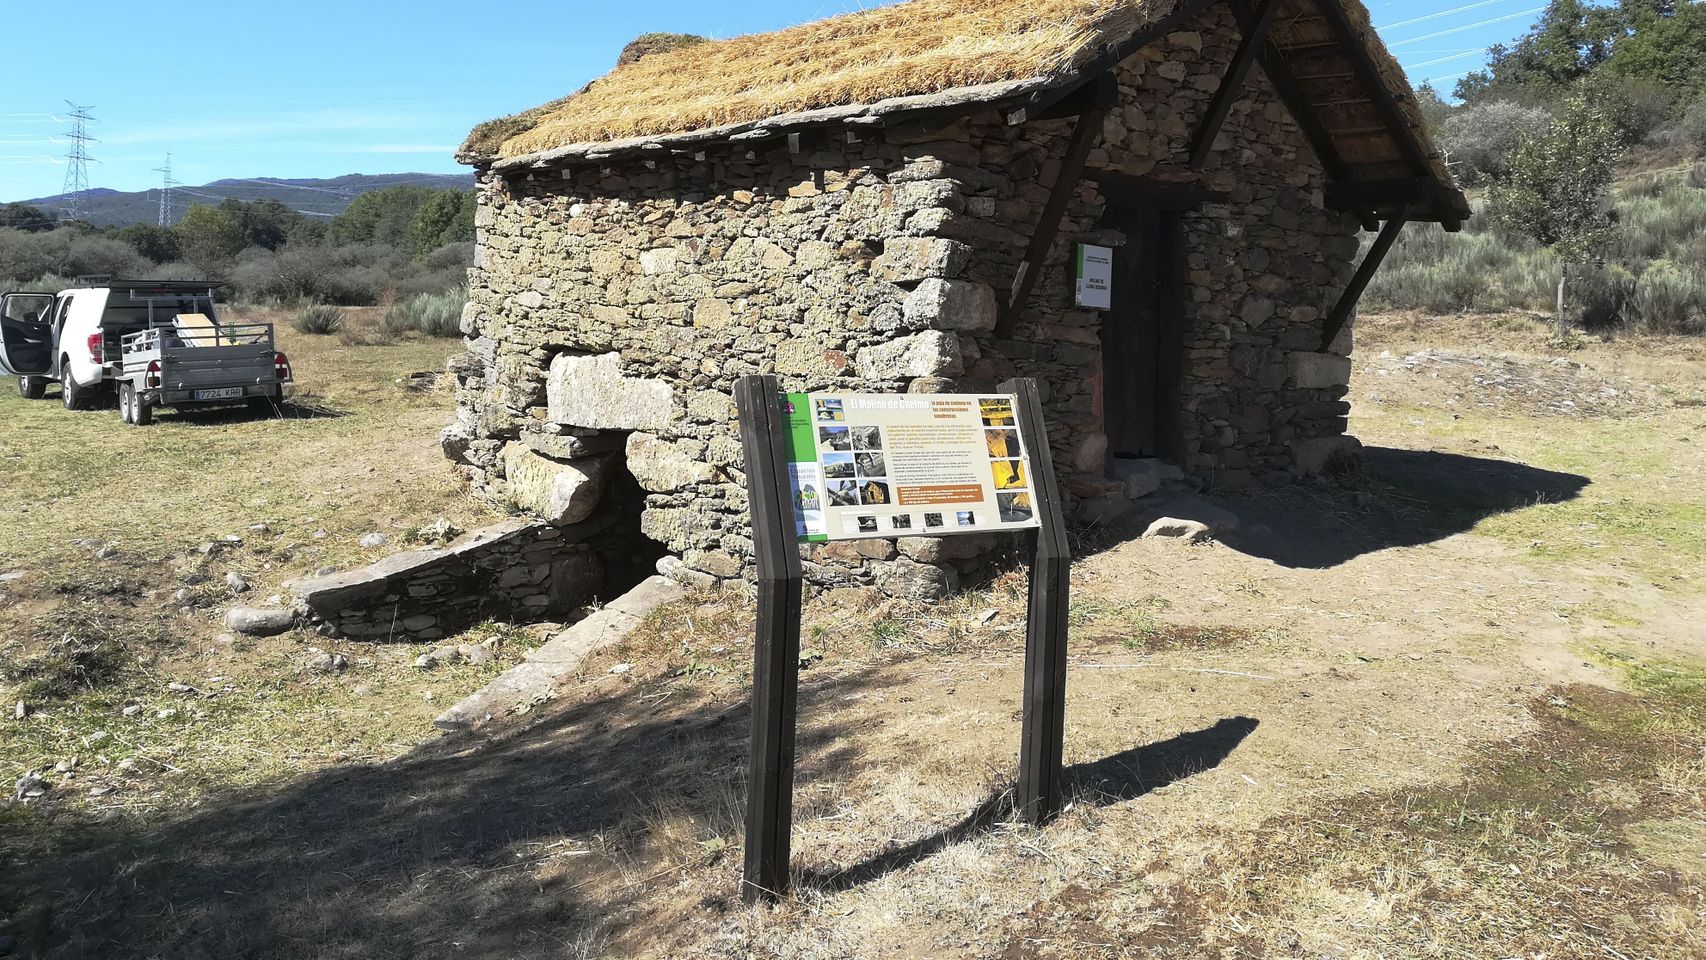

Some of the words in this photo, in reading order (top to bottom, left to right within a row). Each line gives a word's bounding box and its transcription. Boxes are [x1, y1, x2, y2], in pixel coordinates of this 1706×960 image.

[200, 390, 221, 399] 7724
[850, 399, 858, 409] El
[859, 399, 887, 409] Molino
[888, 399, 898, 409] de
